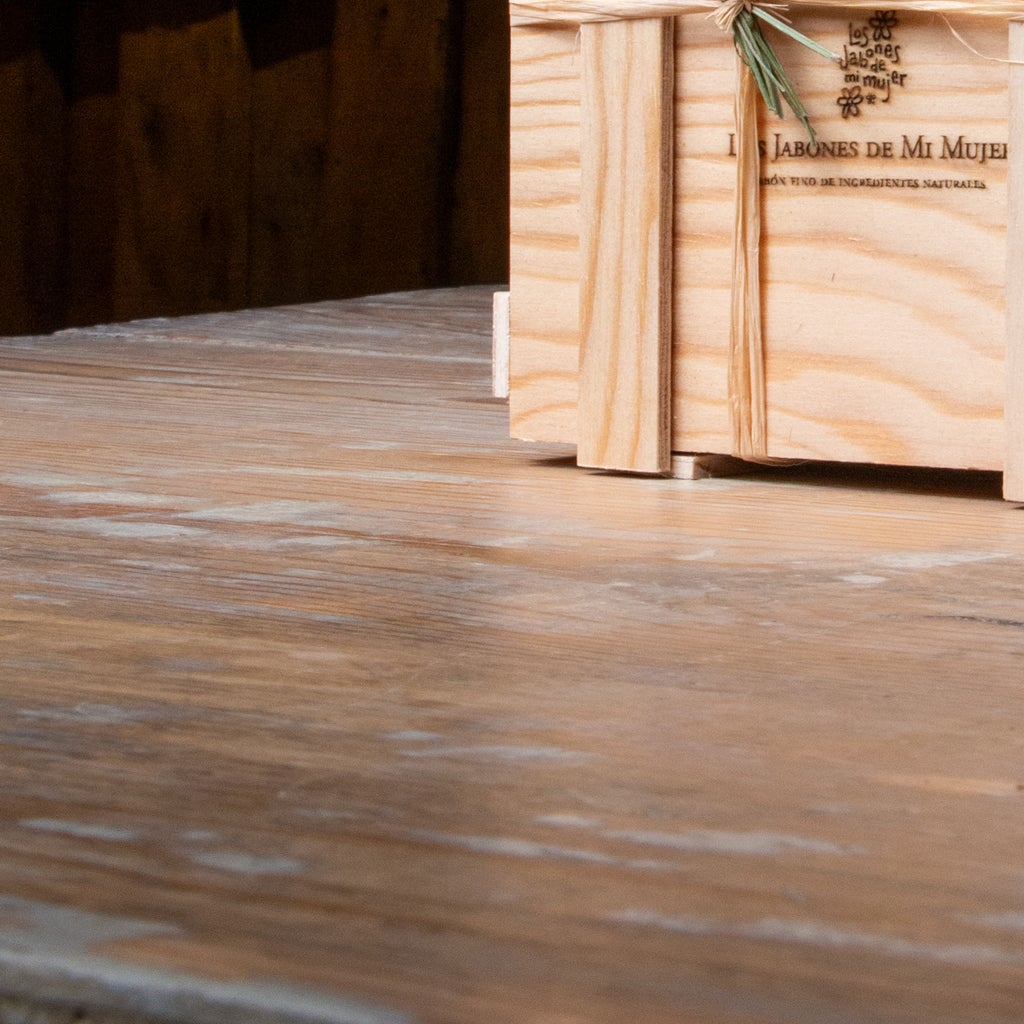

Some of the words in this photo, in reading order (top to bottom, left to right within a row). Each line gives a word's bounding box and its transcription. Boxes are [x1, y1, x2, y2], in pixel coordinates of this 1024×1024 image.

[848, 21, 869, 47] Los
[840, 44, 901, 70] Jabones
[870, 58, 886, 72] de
[844, 70, 860, 83] mi
[862, 70, 908, 102] mujer
[728, 133, 767, 157] LS
[771, 133, 859, 163] JABONES
[866, 142, 894, 158] DE
[901, 135, 933, 159] MI
[759, 175, 786, 187] ABÓN
[790, 176, 817, 187] FINO
[820, 177, 836, 187] DE
[839, 177, 919, 189] INGREDIENTES
[922, 178, 987, 190] NATURALES
